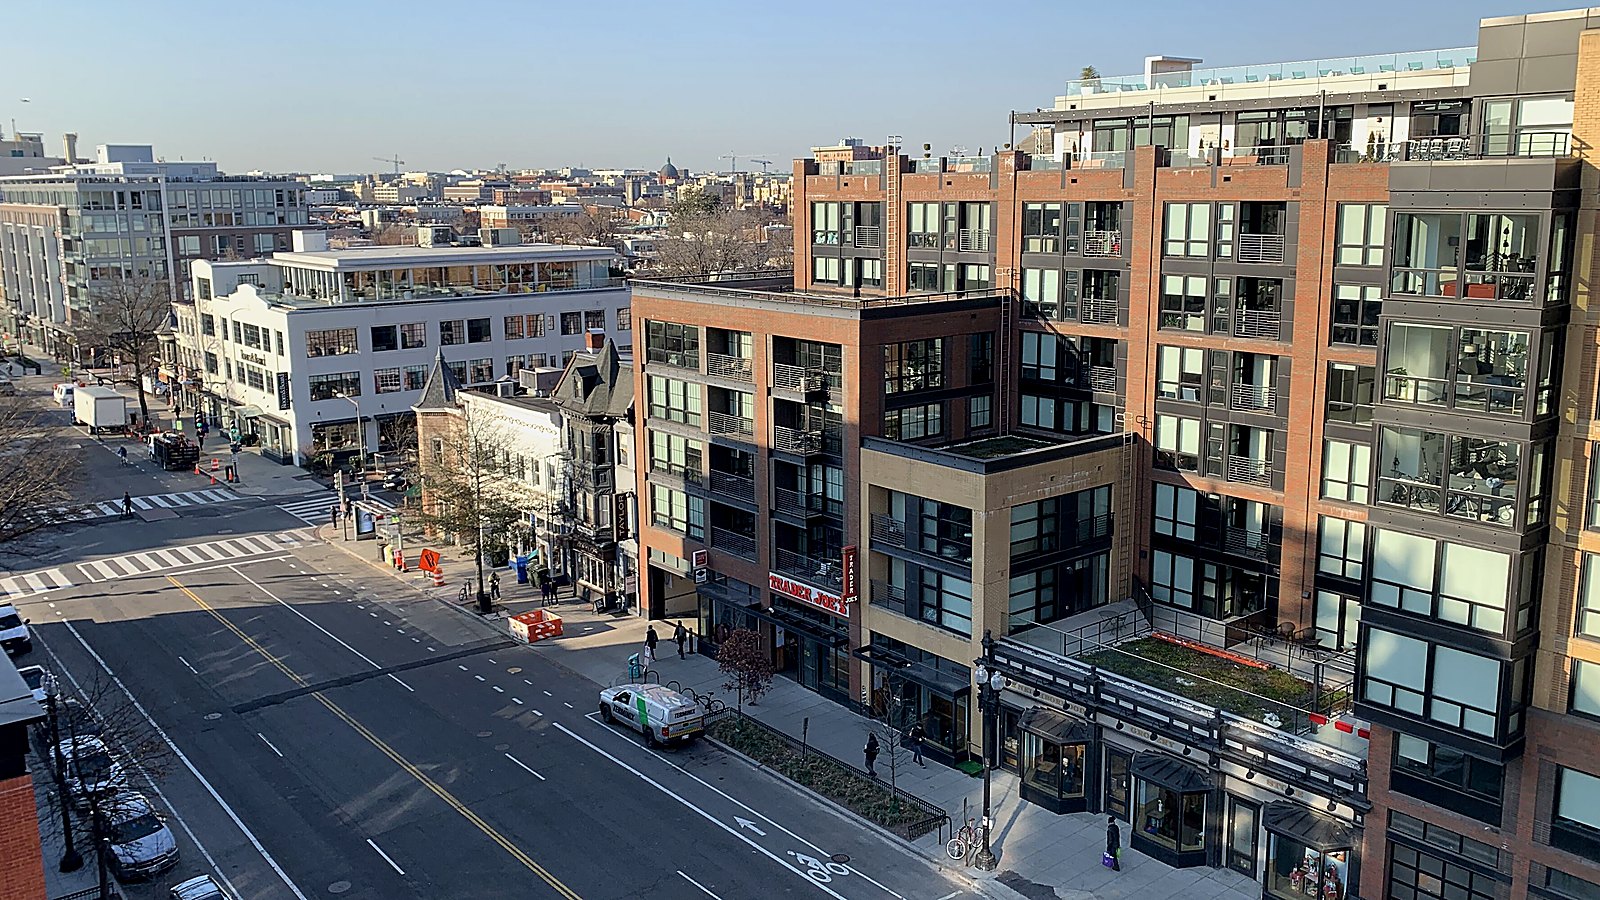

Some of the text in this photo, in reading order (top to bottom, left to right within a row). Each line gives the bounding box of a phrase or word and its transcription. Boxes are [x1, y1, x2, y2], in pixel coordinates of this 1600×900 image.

[769, 575, 847, 615] TRADER JOE'S
[845, 595, 858, 604] JOE'S
[1130, 727, 1174, 747] GROERY
